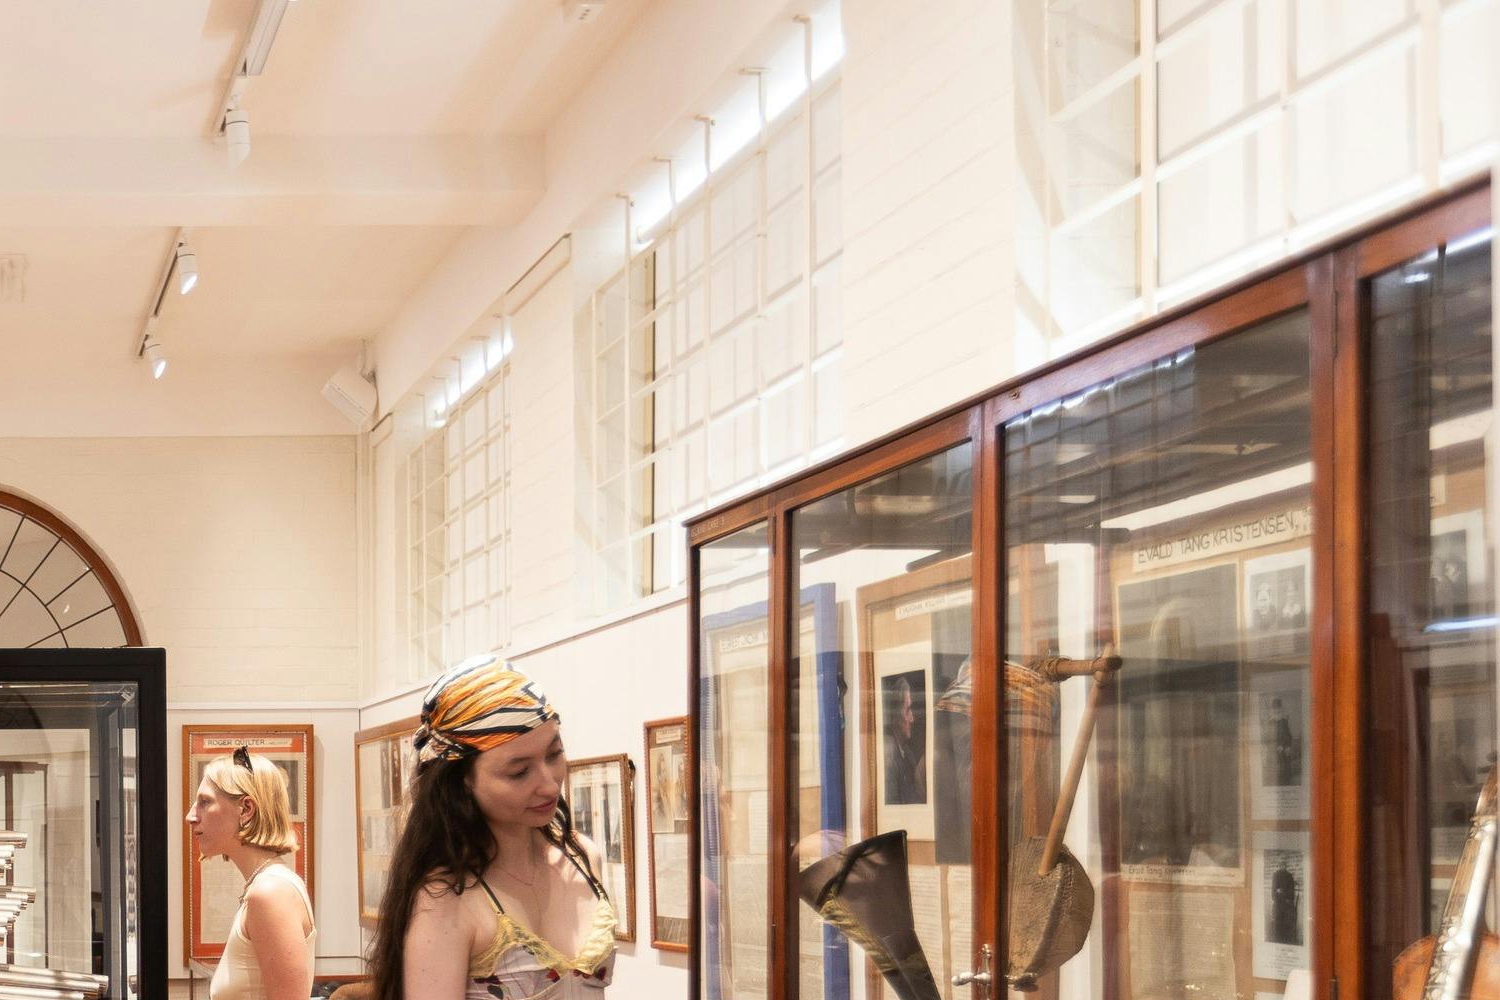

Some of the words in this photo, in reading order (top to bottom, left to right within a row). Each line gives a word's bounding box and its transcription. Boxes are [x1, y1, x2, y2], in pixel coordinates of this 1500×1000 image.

[1137, 540, 1173, 564] EVALD
[1180, 532, 1210, 555] TANG
[207, 738, 232, 746] ROGER
